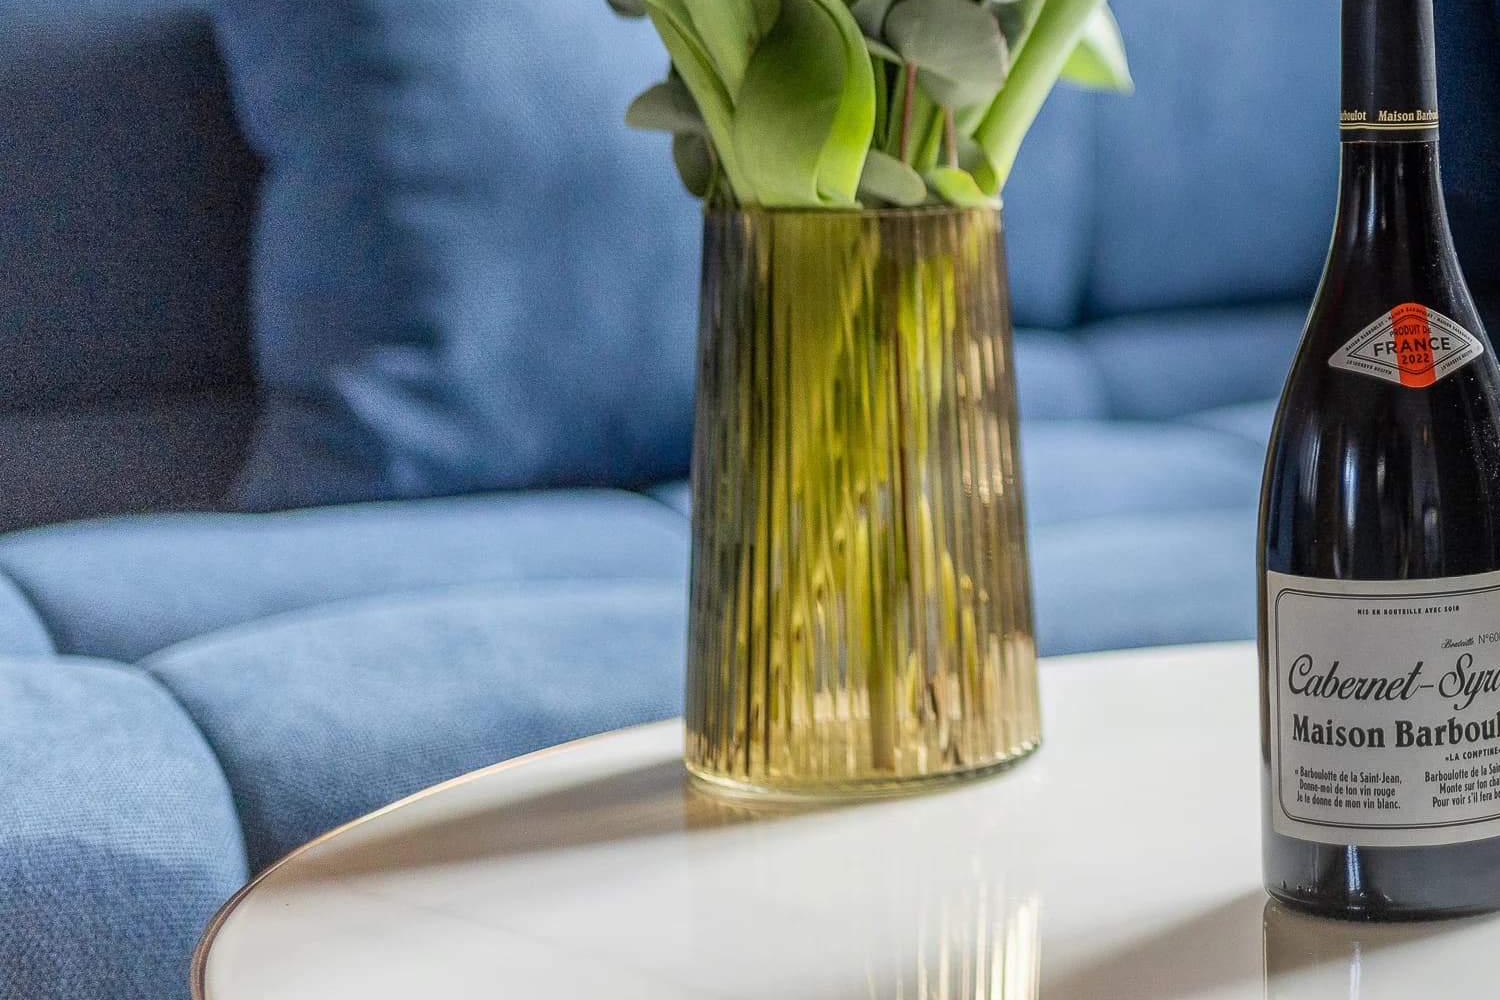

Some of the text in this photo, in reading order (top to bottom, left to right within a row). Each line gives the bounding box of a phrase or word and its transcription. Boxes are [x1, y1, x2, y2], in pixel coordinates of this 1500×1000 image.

[1379, 110, 1414, 121] Maison
[1390, 324, 1432, 337] PRODUIT DE
[1374, 337, 1451, 356] FRANCE
[1402, 353, 1430, 364] 2022
[1357, 608, 1368, 616] MIS
[1425, 606, 1442, 614] AVEC
[1292, 713, 1386, 748] Maison
[1300, 766, 1338, 782] Barboulotte
[1339, 771, 1349, 782] de
[1350, 771, 1358, 782] la
[1360, 772, 1402, 784] Saint-Jean,
[1424, 769, 1469, 782] Barboulotte
[1471, 766, 1479, 778] de
[1480, 765, 1487, 776] la
[1300, 778, 1396, 797] Donne-moi de ton vin rouge
[1440, 782, 1462, 794] Monte
[1464, 782, 1475, 791] sur
[1477, 778, 1487, 790] ton
[1297, 790, 1303, 802] Je
[1312, 794, 1332, 806] donne
[1334, 796, 1343, 807] de
[1345, 799, 1360, 808] mon
[1363, 798, 1374, 809] vin
[1377, 798, 1400, 809] blanc.
[1432, 796, 1450, 807] Pour
[1451, 794, 1466, 806] voir
